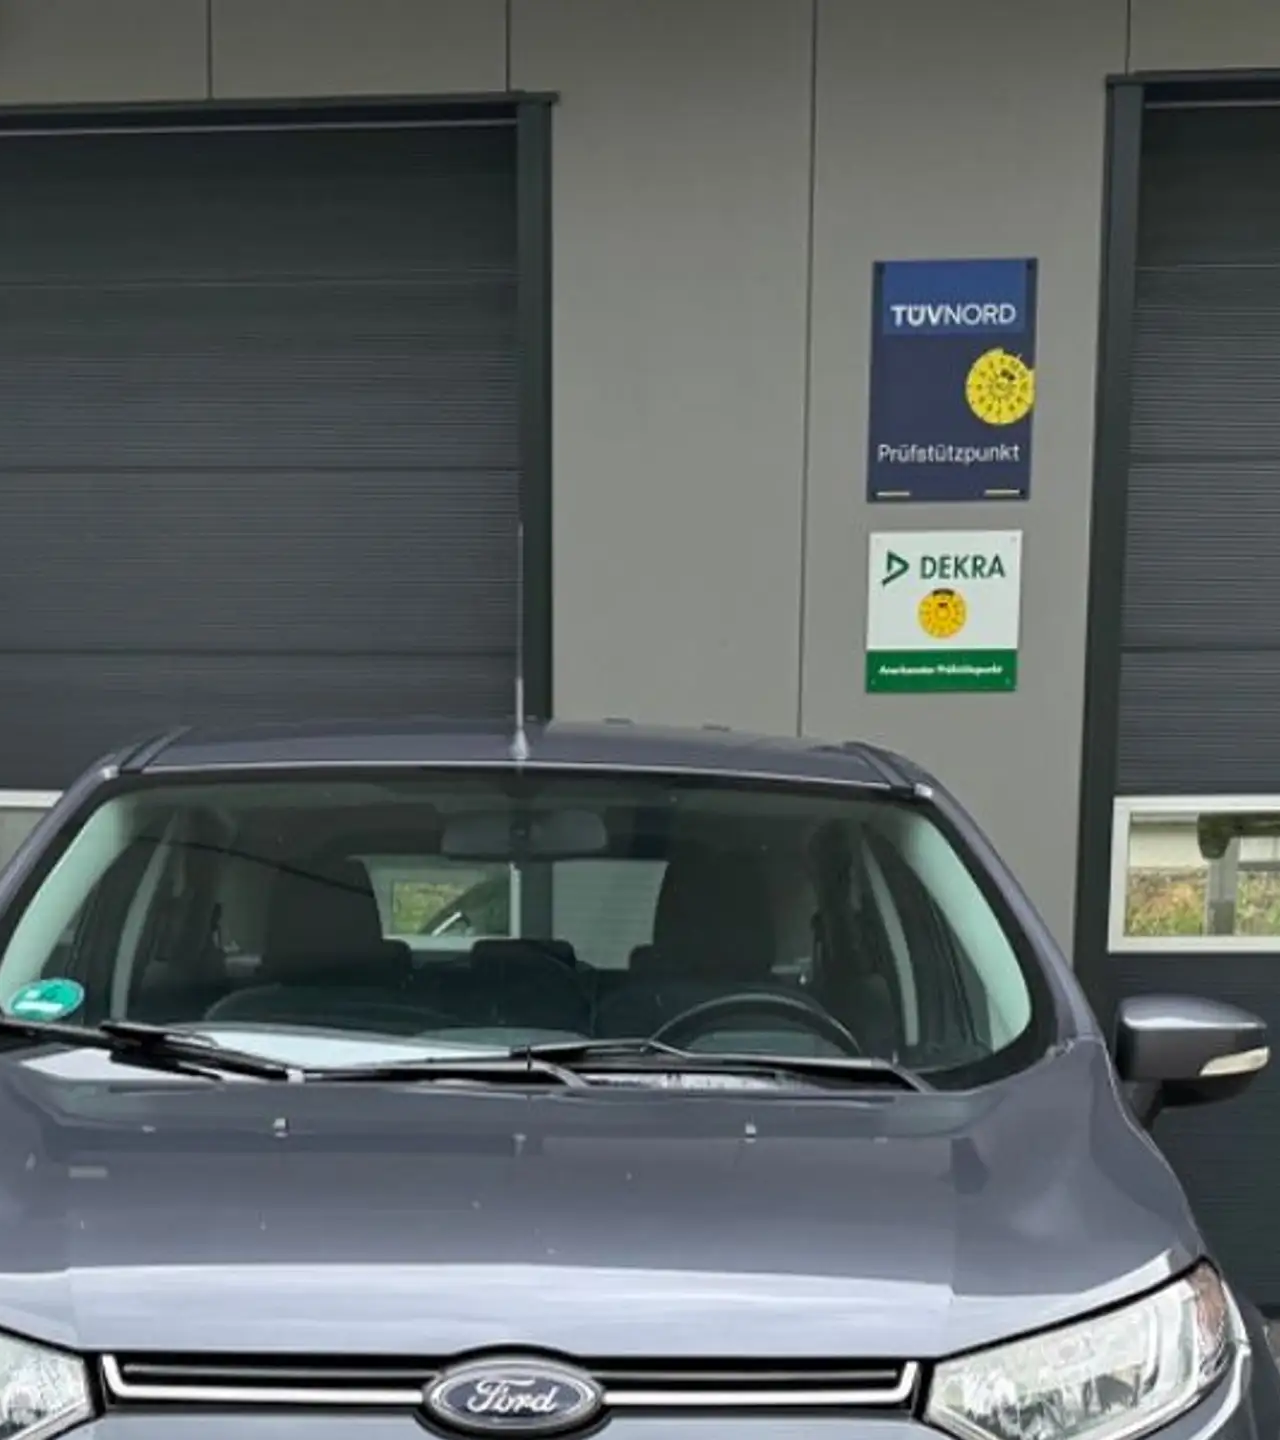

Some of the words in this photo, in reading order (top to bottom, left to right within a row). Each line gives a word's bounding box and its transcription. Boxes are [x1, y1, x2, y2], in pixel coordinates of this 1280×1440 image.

[877, 443, 1020, 466] Prüfstützpunkt
[920, 554, 1006, 580] DEKRA
[467, 1377, 561, 1414] Ford
